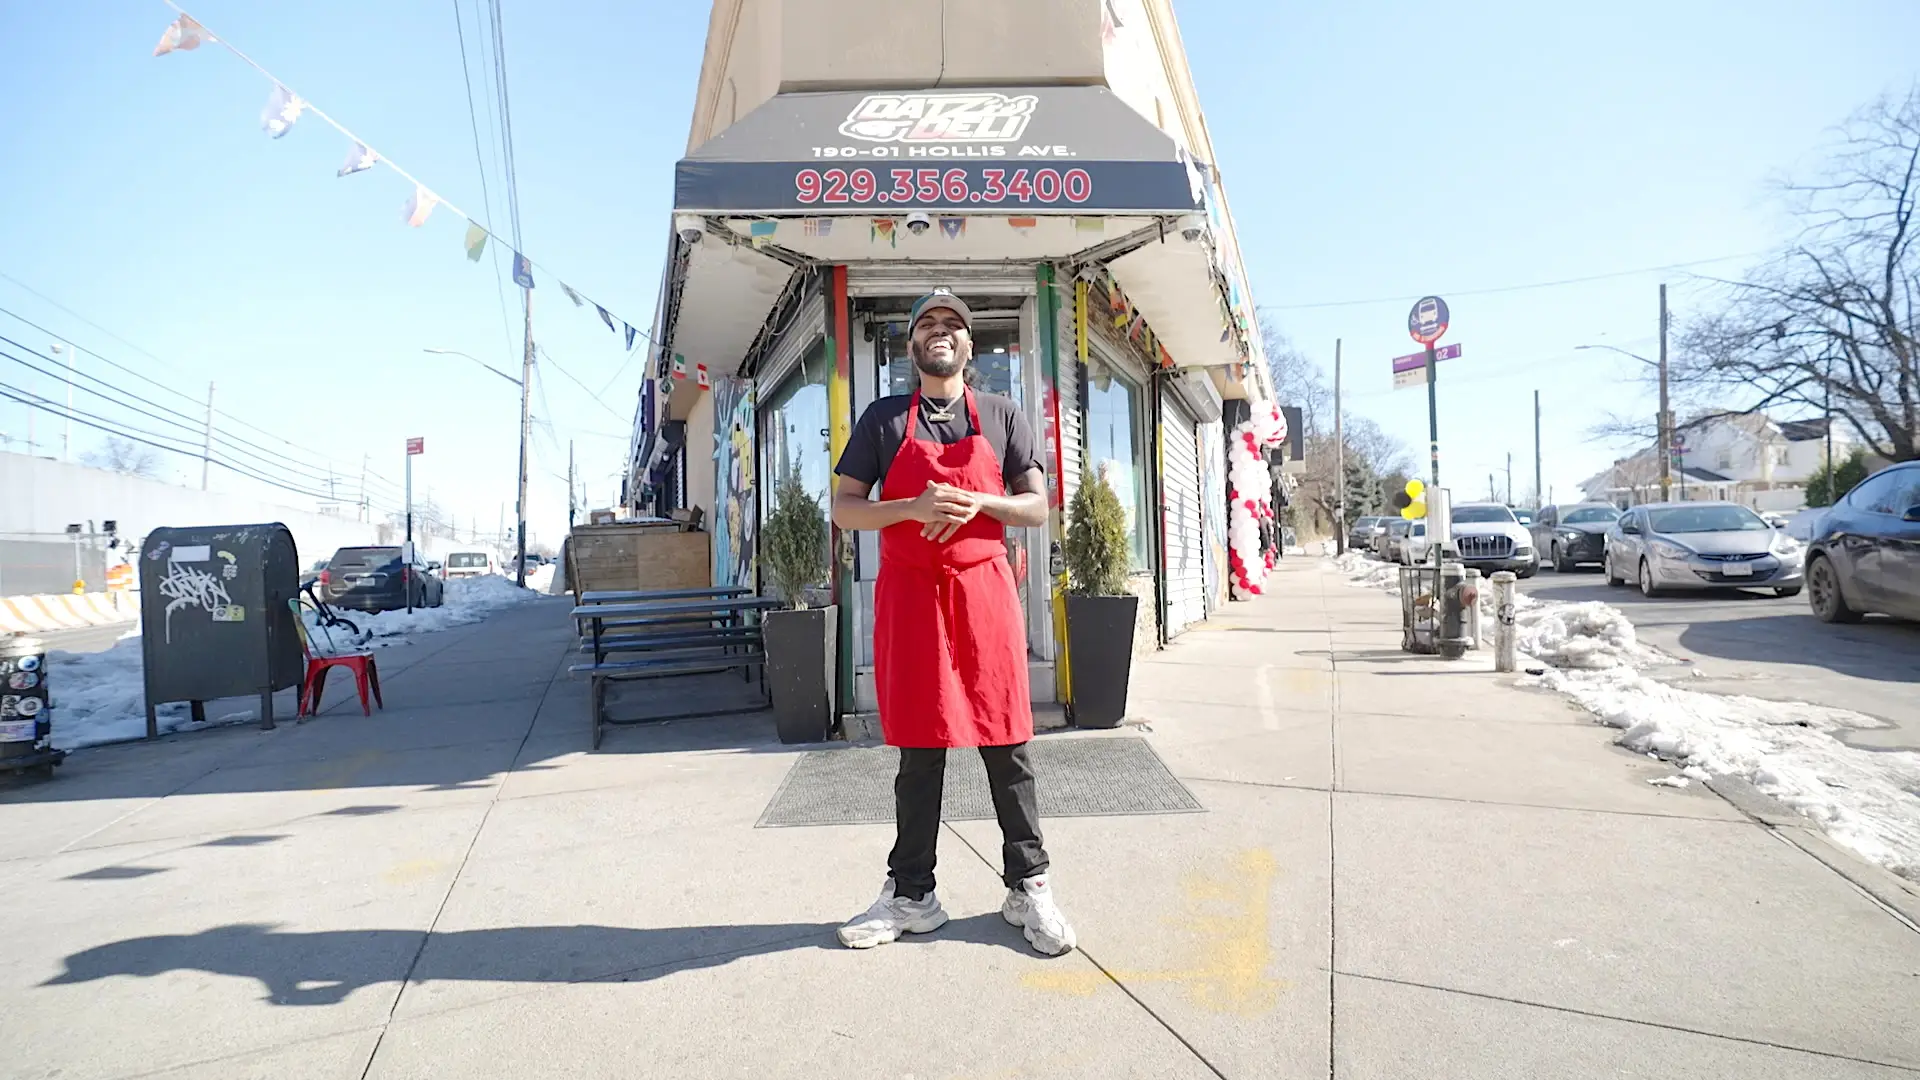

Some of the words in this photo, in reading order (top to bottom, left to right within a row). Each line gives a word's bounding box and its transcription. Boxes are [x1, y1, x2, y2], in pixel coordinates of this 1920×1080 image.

[859, 97, 1001, 120] DATZ
[907, 116, 1020, 140] DELI
[812, 146, 899, 157] 190-01
[909, 146, 1007, 157] HOLLIS
[1017, 145, 1077, 157] AVE.
[795, 168, 1093, 204] 929.356.3400
